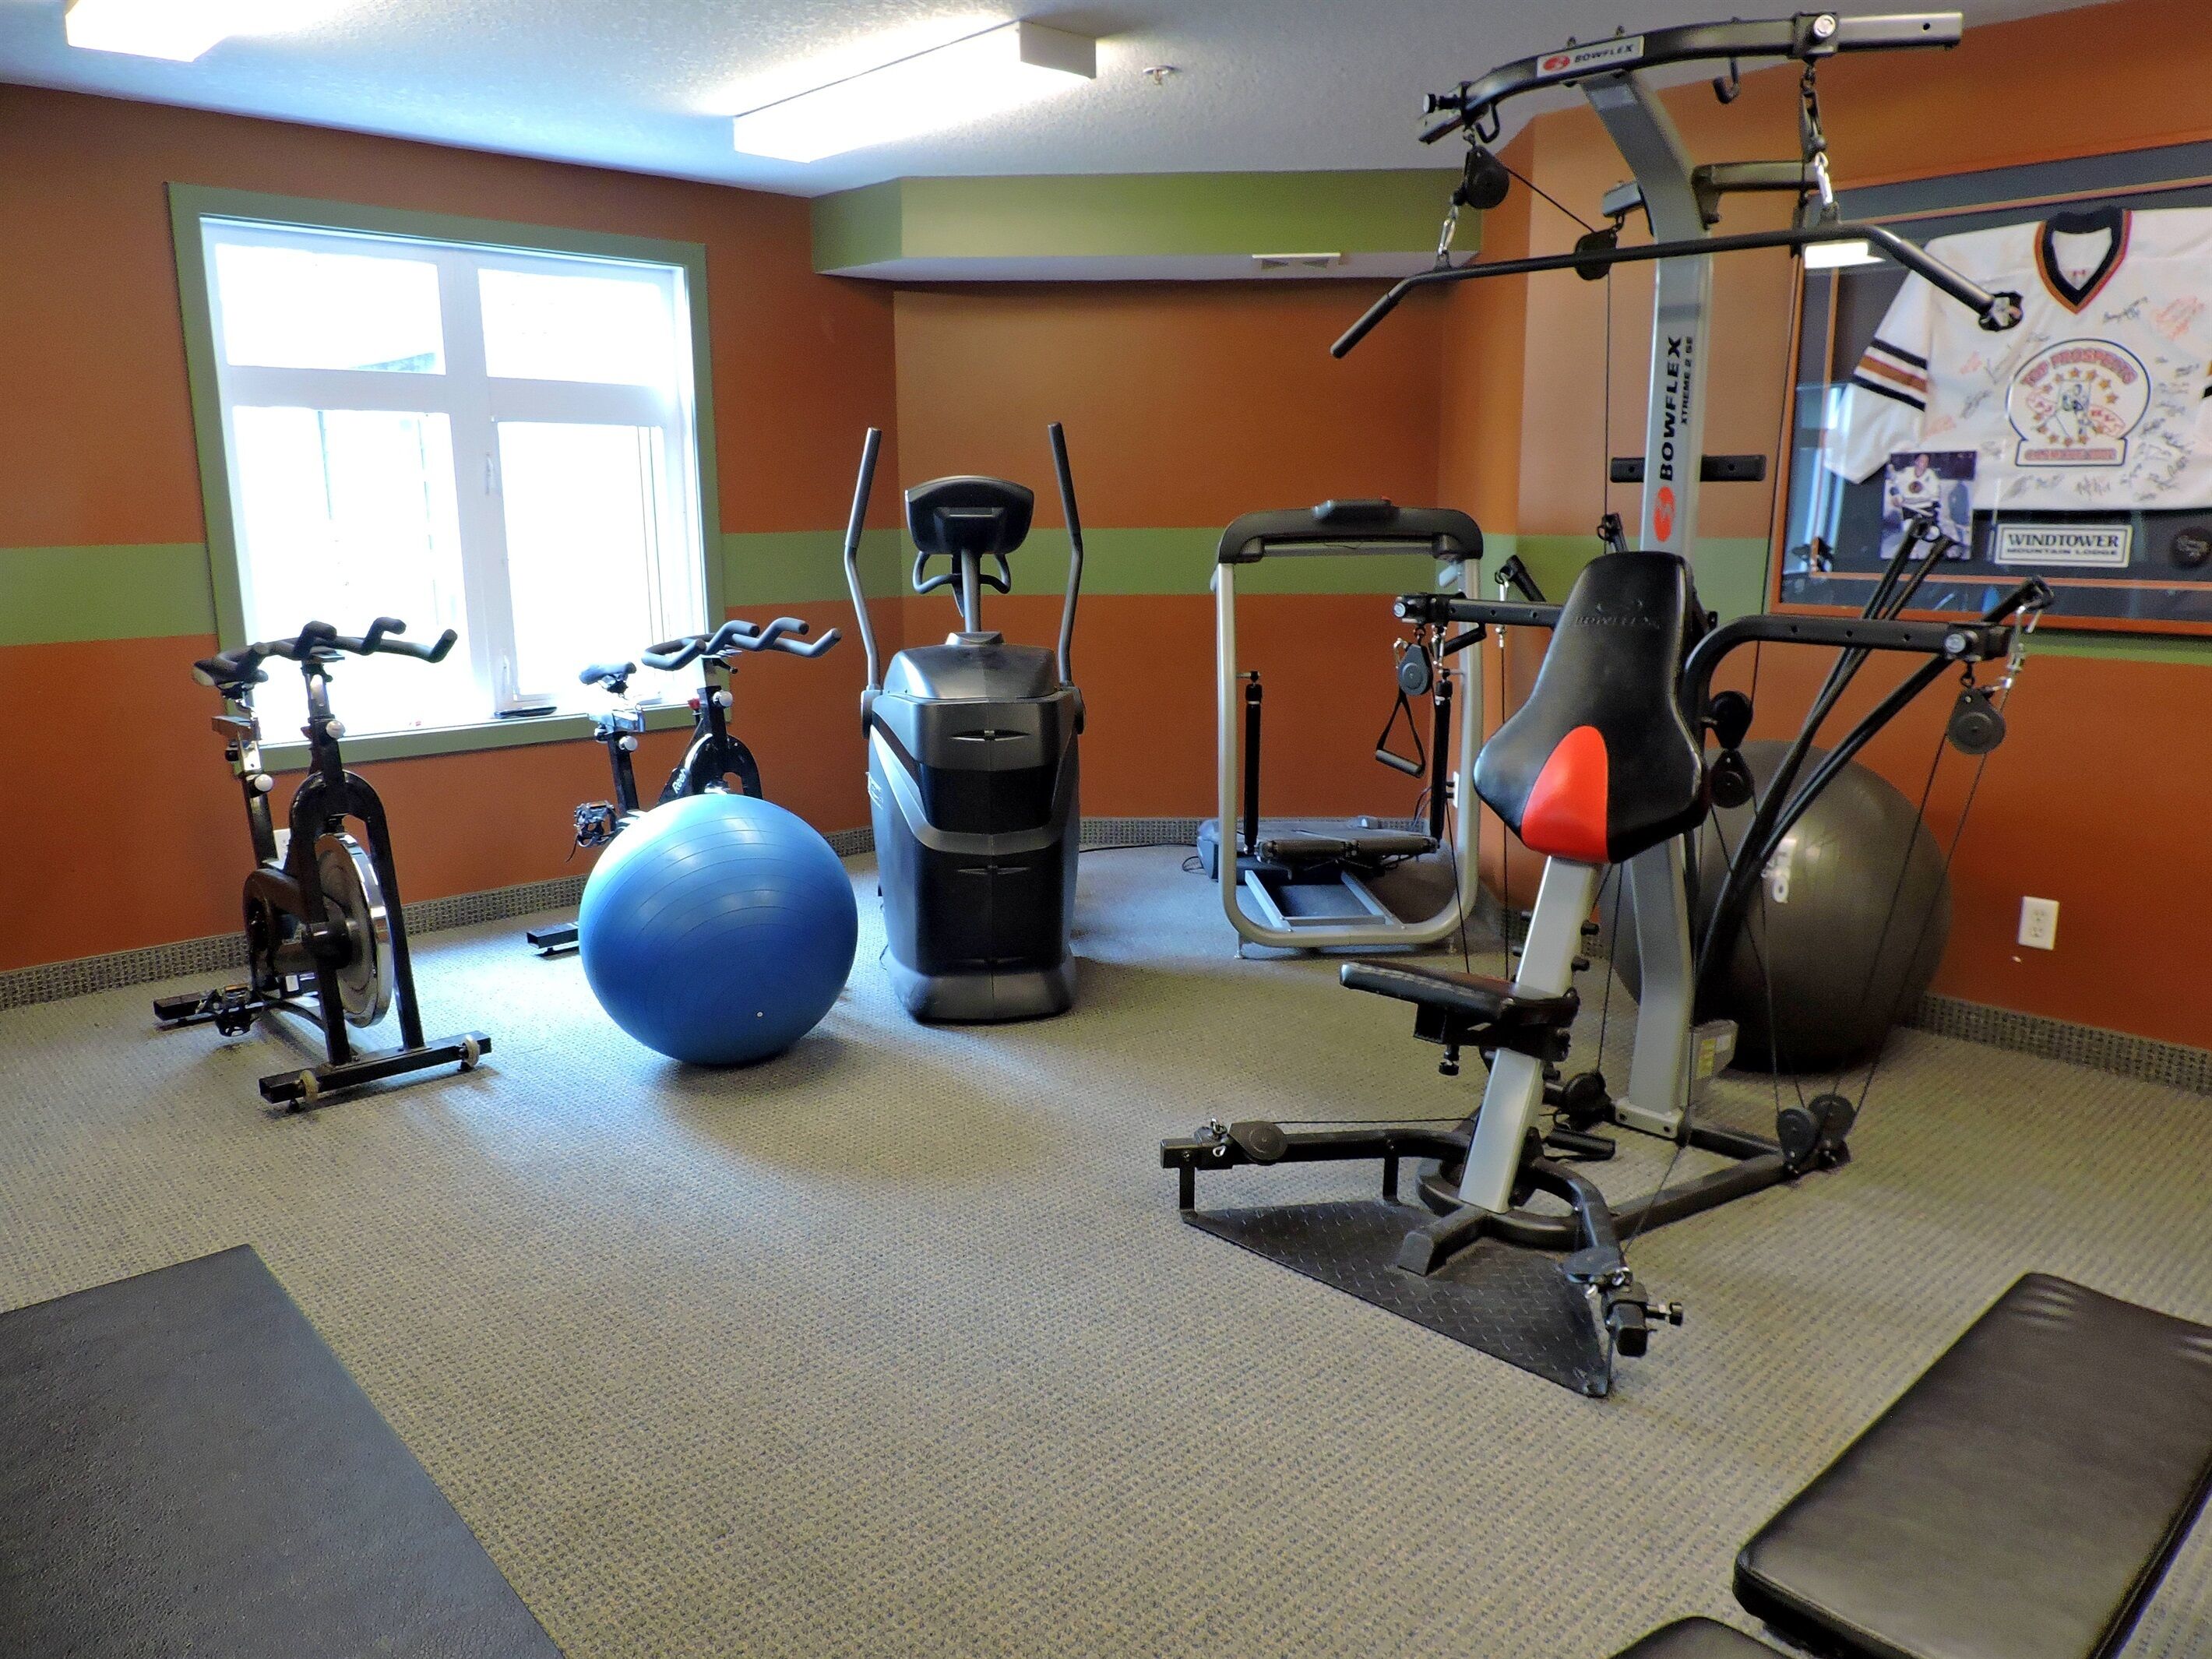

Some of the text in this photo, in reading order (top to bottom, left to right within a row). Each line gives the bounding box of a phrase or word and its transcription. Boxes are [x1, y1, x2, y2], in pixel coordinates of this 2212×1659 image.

[1574, 44, 1634, 63] BOWFLEX
[1685, 358, 1692, 368] 2
[1659, 336, 1682, 481] BOWFLEX
[1681, 373, 1692, 425] XTREME
[2008, 534, 2119, 548] WINDTOWER
